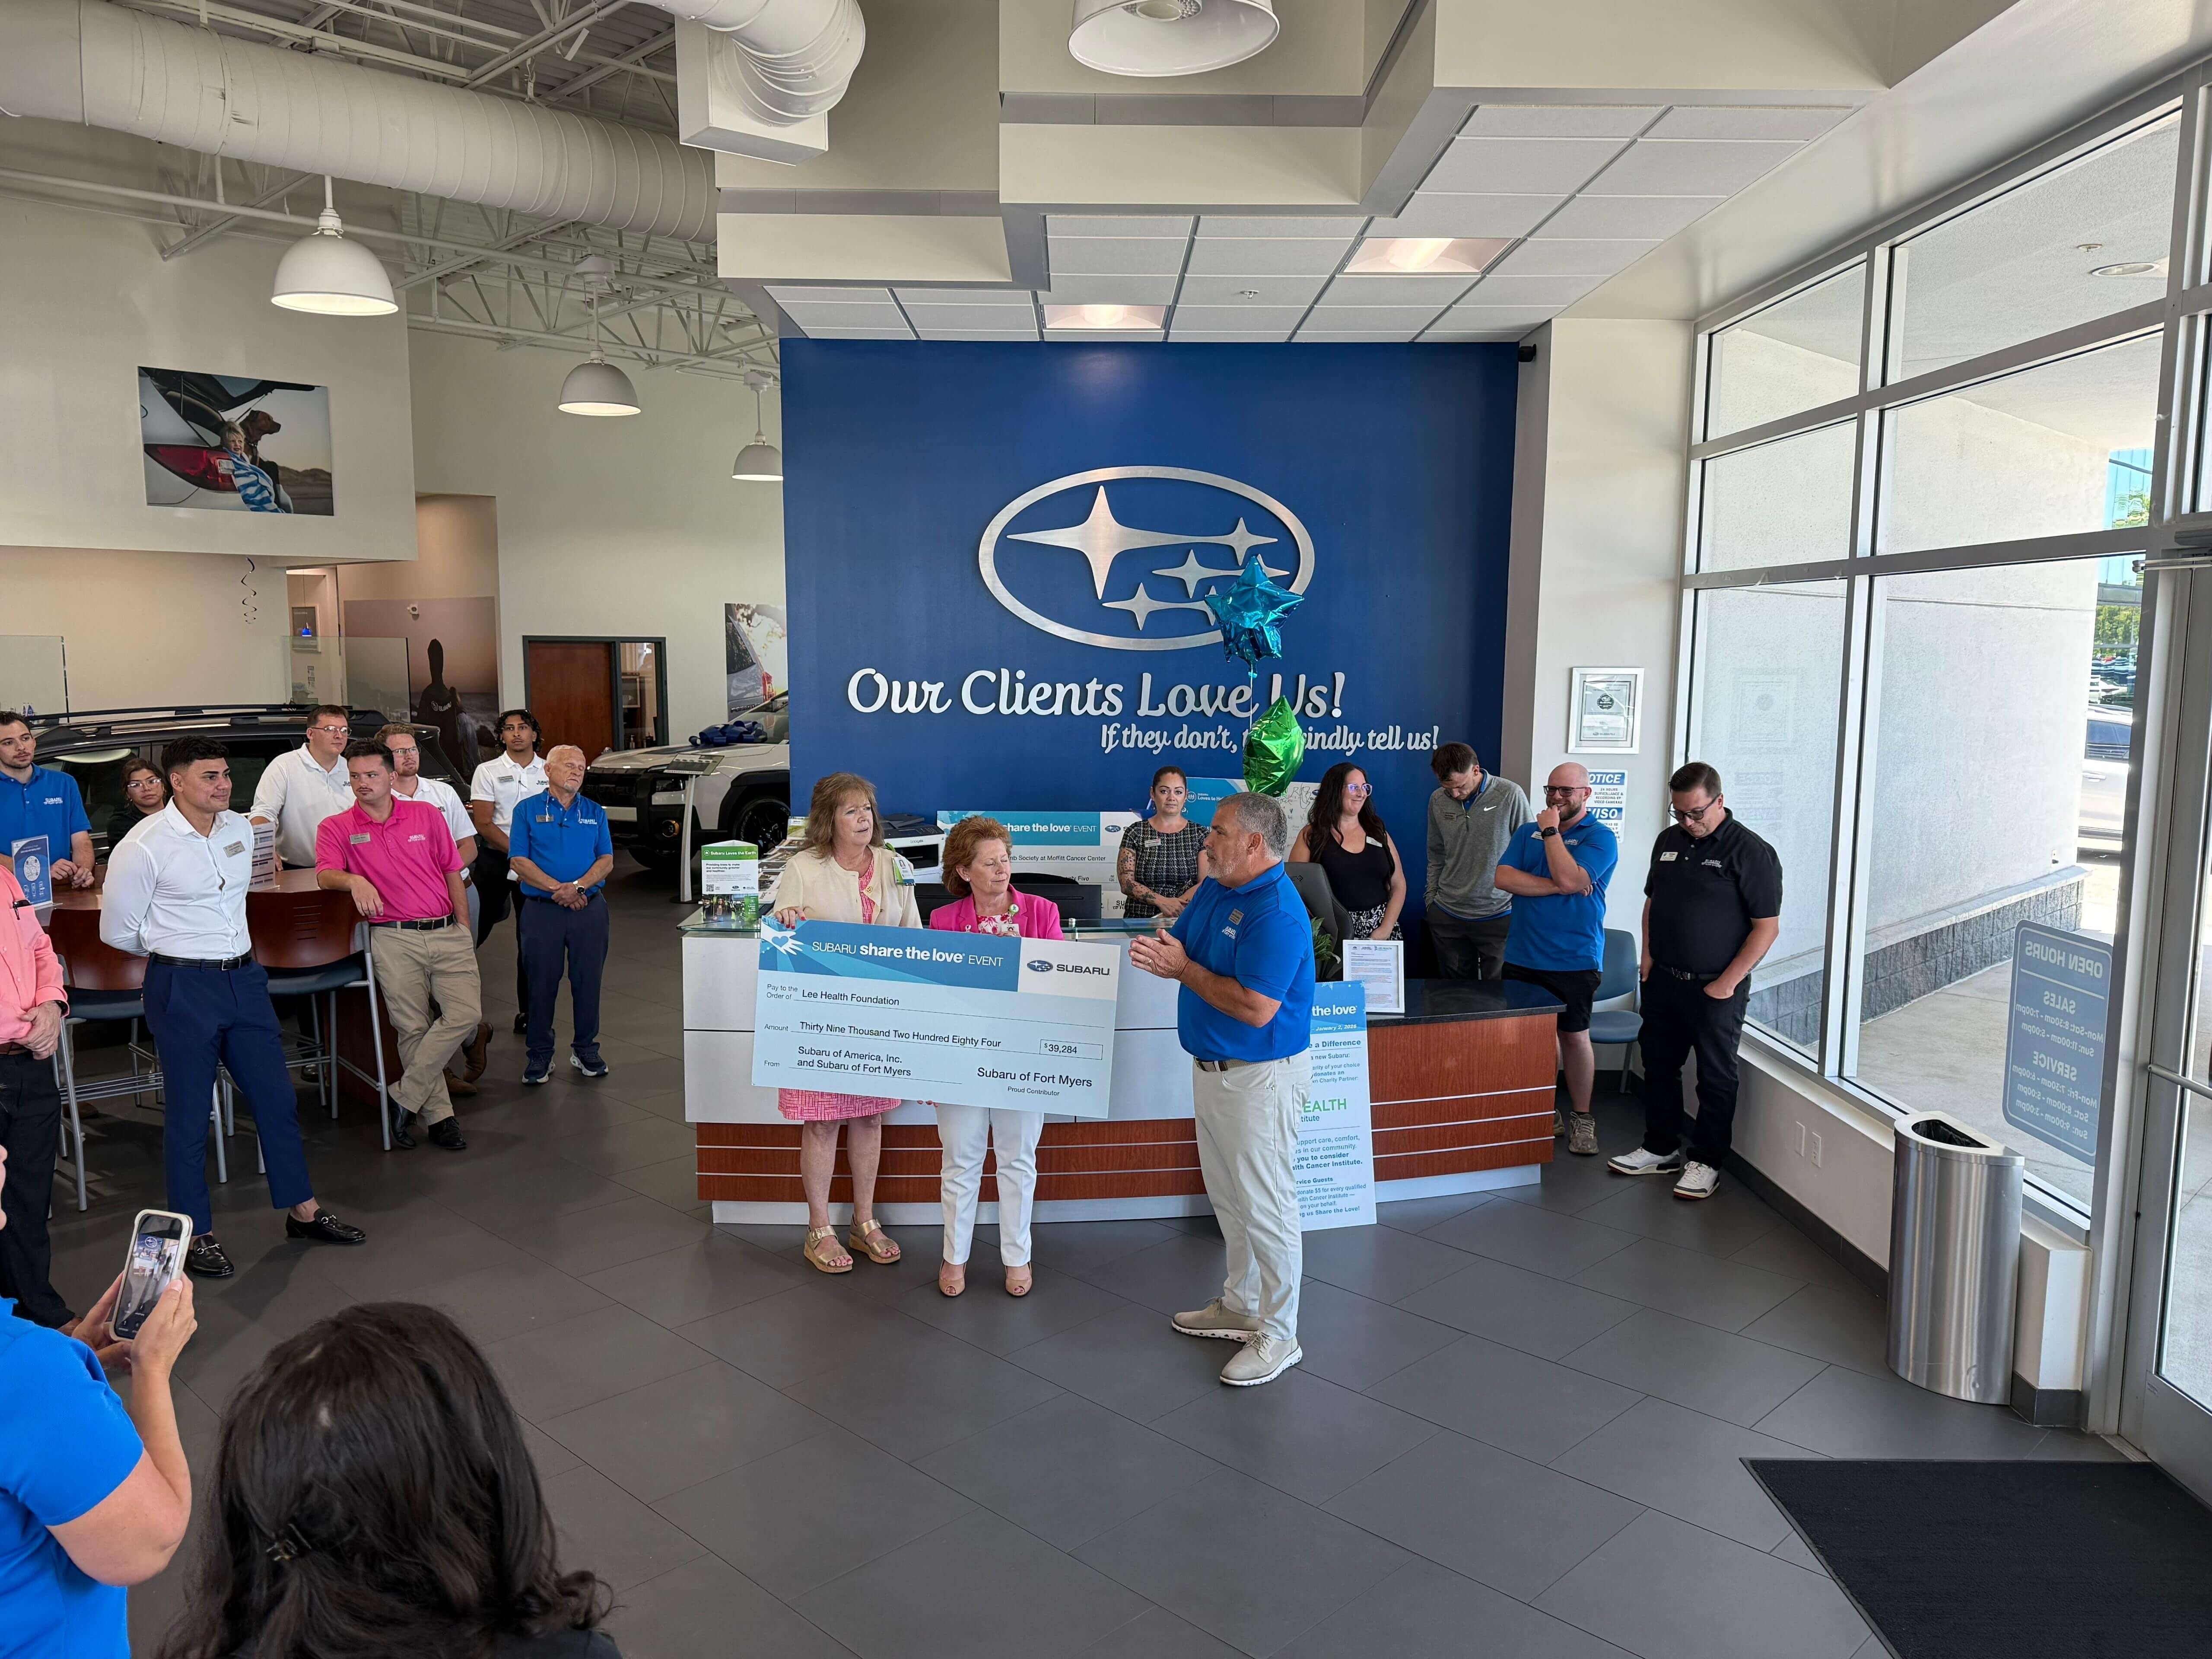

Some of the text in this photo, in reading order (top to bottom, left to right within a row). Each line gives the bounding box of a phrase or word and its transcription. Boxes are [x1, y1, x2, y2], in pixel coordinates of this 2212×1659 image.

[848, 668, 1345, 718] Our Clients Love Us!
[1101, 723, 1120, 753] If
[1122, 724, 1172, 755] they
[1174, 725, 1237, 753] don't,
[1303, 725, 1365, 756] indly
[1368, 726, 1404, 751] tell
[1407, 726, 1440, 750] us!
[1589, 773, 1622, 783] OTICE
[1592, 808, 1618, 819] VISO
[1032, 823, 1049, 832] the
[1050, 823, 1071, 832] love
[812, 941, 1004, 967] SUBARU share the love EVENT
[1056, 964, 1110, 976] SUBARU
[802, 989, 899, 1006] Lee Health Foundation
[1312, 1004, 1356, 1016] the love
[800, 1021, 1001, 1048] Thirty Nine Thousand Two Hundred Eighty Four
[798, 1046, 903, 1063] Subaru of America, Inc.
[1044, 1042, 1077, 1055] $39,284
[797, 1059, 911, 1077] and Subaru of Fort Myers
[977, 1067, 1093, 1087] Subaru of Fort Myers
[1027, 1088, 1060, 1096] Contributor
[1303, 1098, 1347, 1113] EALTH
